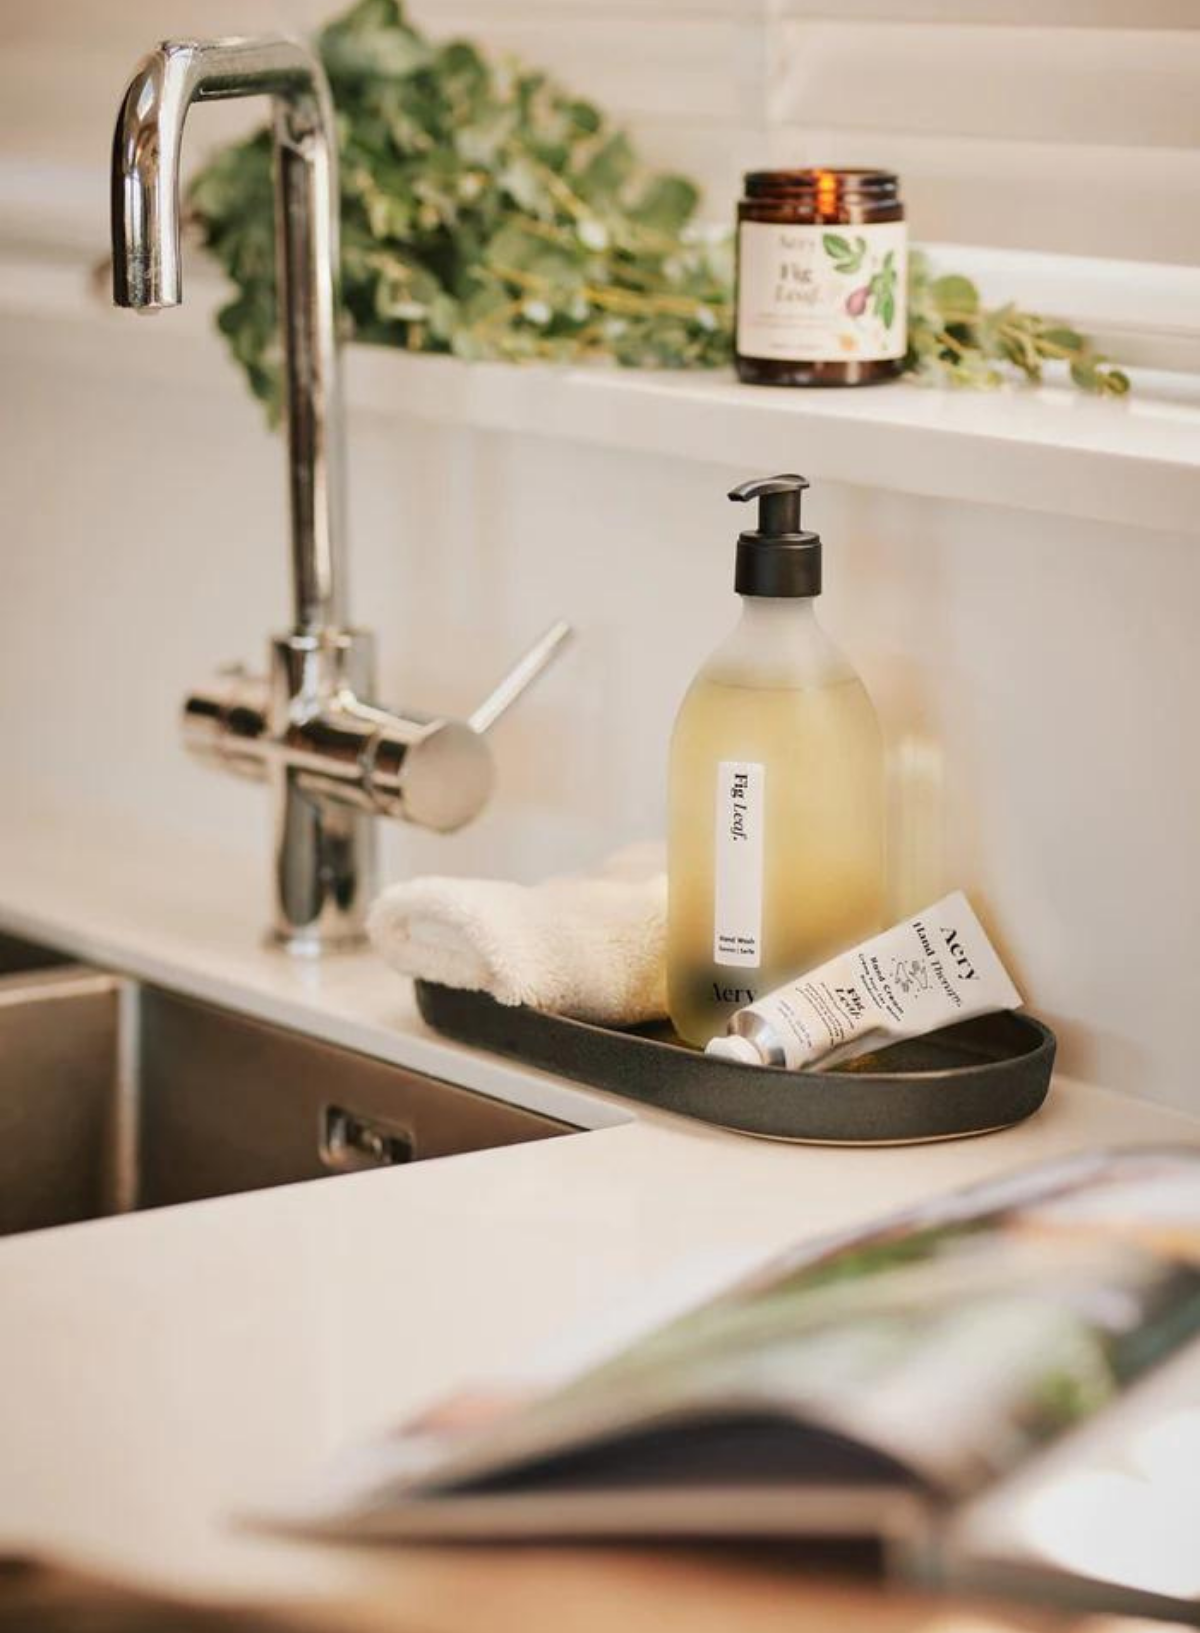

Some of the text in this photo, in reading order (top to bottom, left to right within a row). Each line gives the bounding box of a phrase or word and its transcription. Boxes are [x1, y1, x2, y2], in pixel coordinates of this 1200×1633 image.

[730, 774, 748, 841] Fig Leaf.
[719, 935, 755, 945] Hand Wash
[912, 920, 935, 957] Hand
[938, 927, 980, 980] Aery
[869, 956, 886, 982] Hand
[713, 982, 758, 1006] Aery
[846, 987, 866, 1011] Fig
